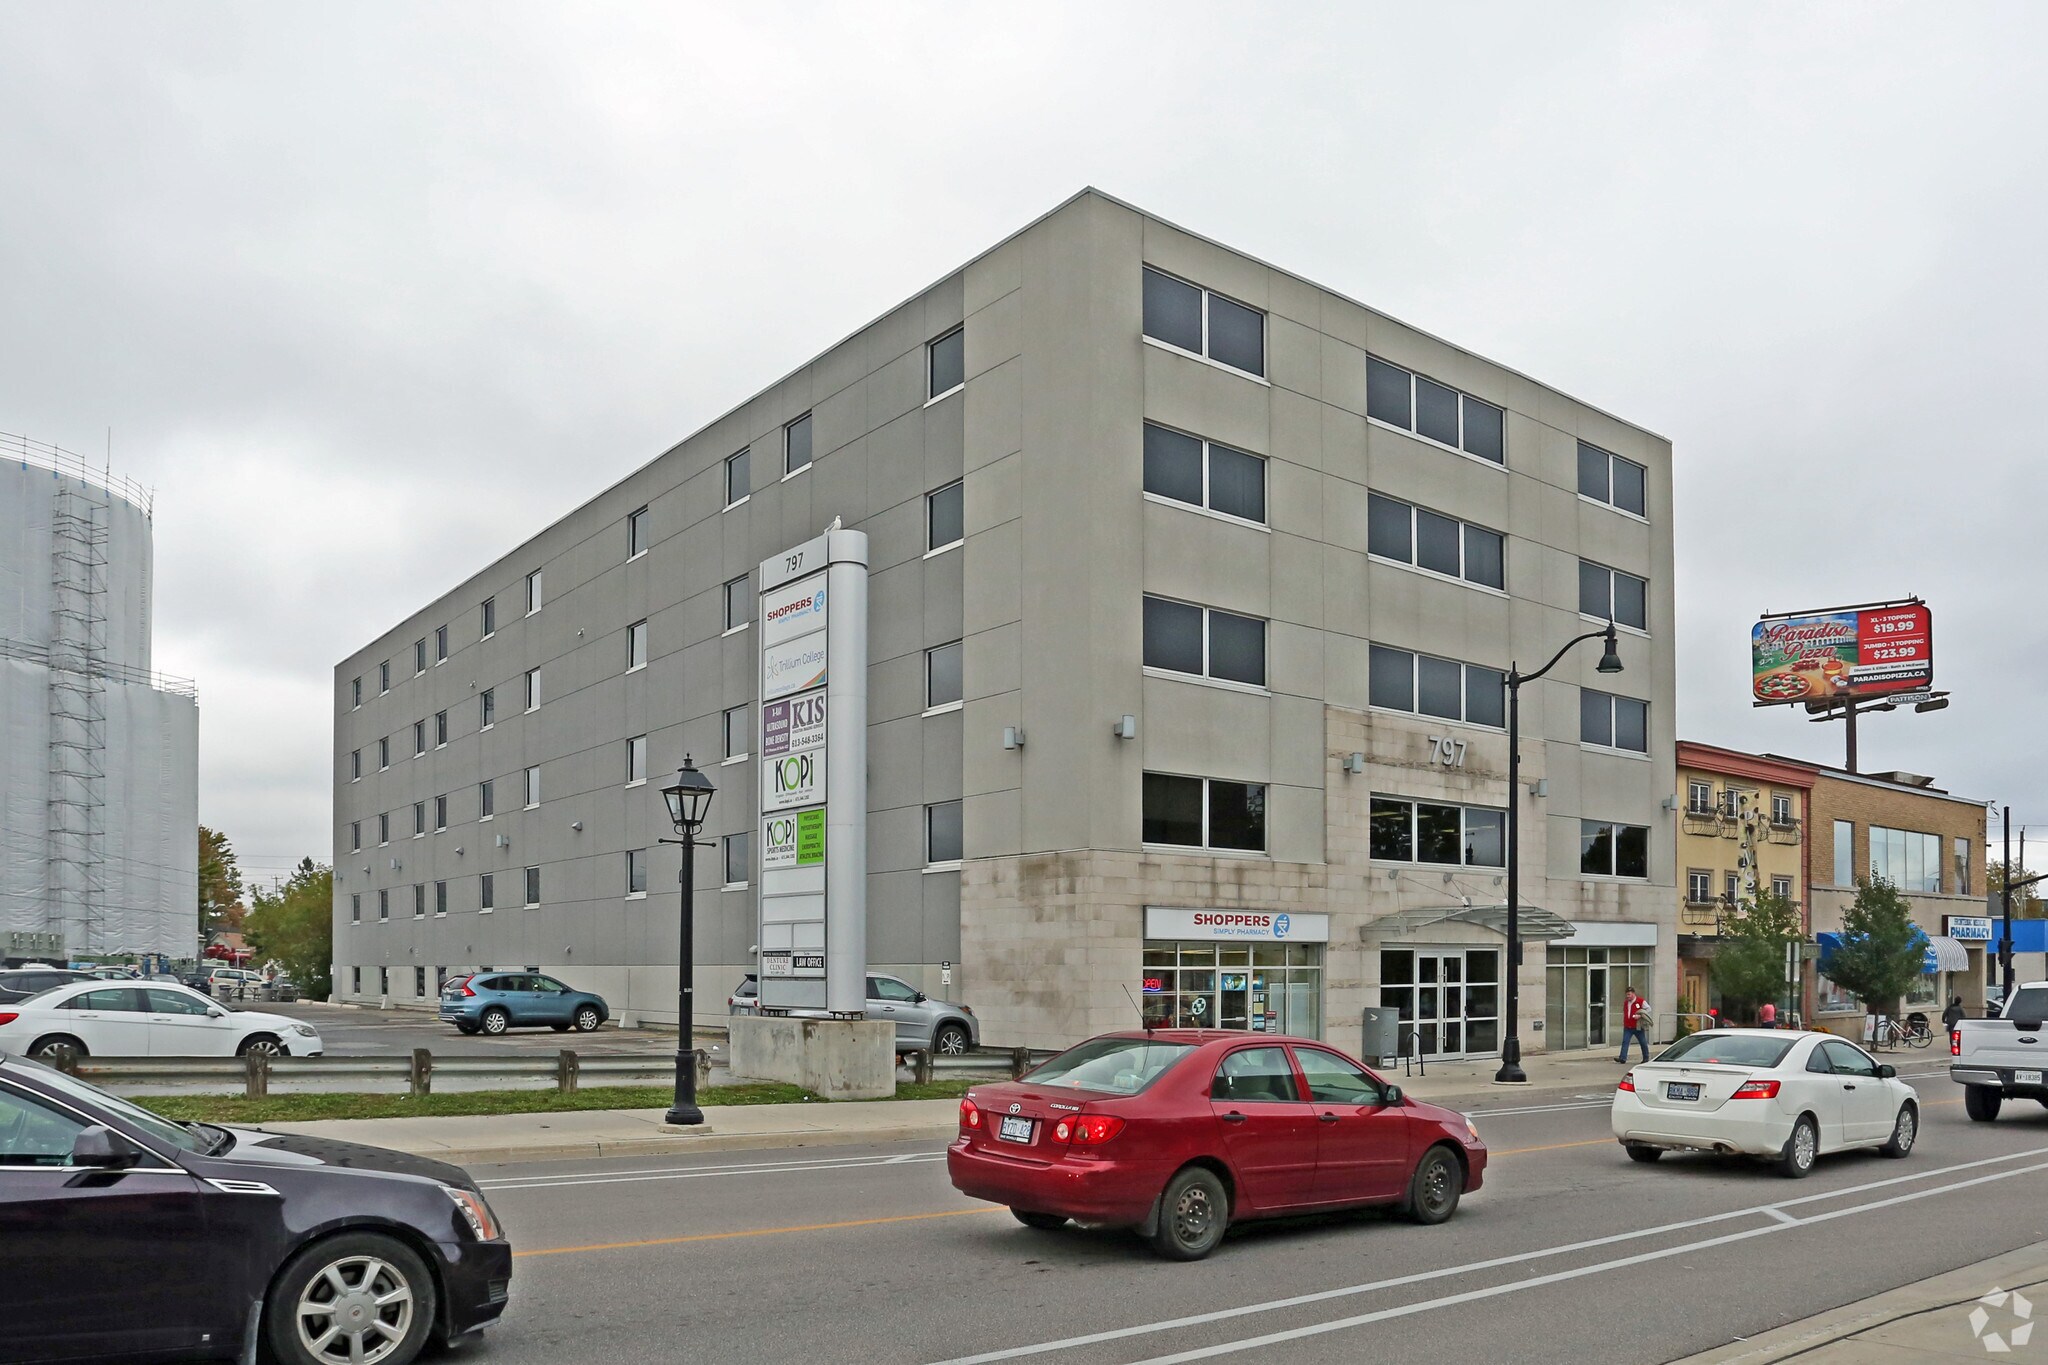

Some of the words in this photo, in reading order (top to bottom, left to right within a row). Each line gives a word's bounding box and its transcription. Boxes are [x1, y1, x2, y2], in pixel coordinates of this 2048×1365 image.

[785, 552, 804, 573] 797
[767, 597, 812, 621] SHOPPERS
[1888, 613, 1916, 621] TOPPING
[1767, 622, 1849, 643] Paradiso
[1873, 621, 1915, 633] $19.99
[1780, 642, 1835, 662] Pizza
[1863, 642, 1887, 650] JUMBO
[1873, 647, 1916, 659] $23.99
[779, 657, 802, 672] Trillium
[802, 650, 825, 665] College
[1853, 670, 1926, 682] PARADISOPIZZA.CA
[1890, 694, 1928, 703] PATTISON
[792, 695, 825, 729] KIS
[1428, 735, 1467, 767] 797
[766, 847, 779, 855] SPORTS
[1193, 913, 1270, 927] SHOPPERS
[1237, 928, 1270, 936] PHARMACY
[1950, 927, 1989, 938] PHARMACY
[797, 958, 806, 967] LAW
[807, 957, 822, 967] OFFICE
